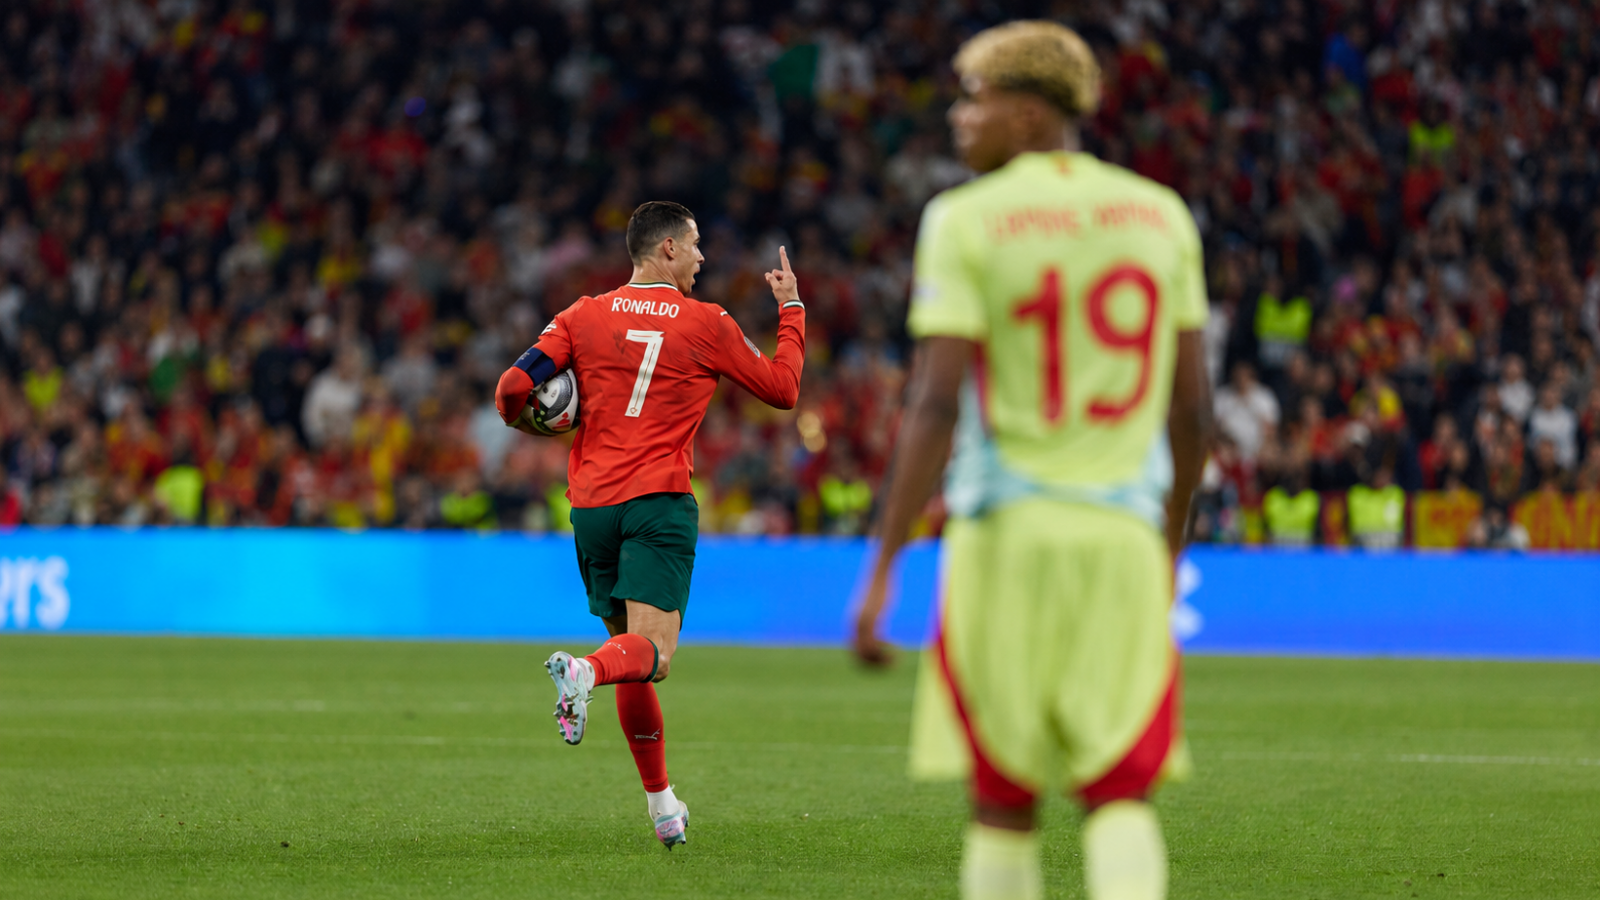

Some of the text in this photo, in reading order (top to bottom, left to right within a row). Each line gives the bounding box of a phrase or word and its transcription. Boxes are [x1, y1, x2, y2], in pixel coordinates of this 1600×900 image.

[611, 297, 679, 318] RONALDO
[1011, 263, 1160, 426] 19
[624, 329, 665, 417] 7
